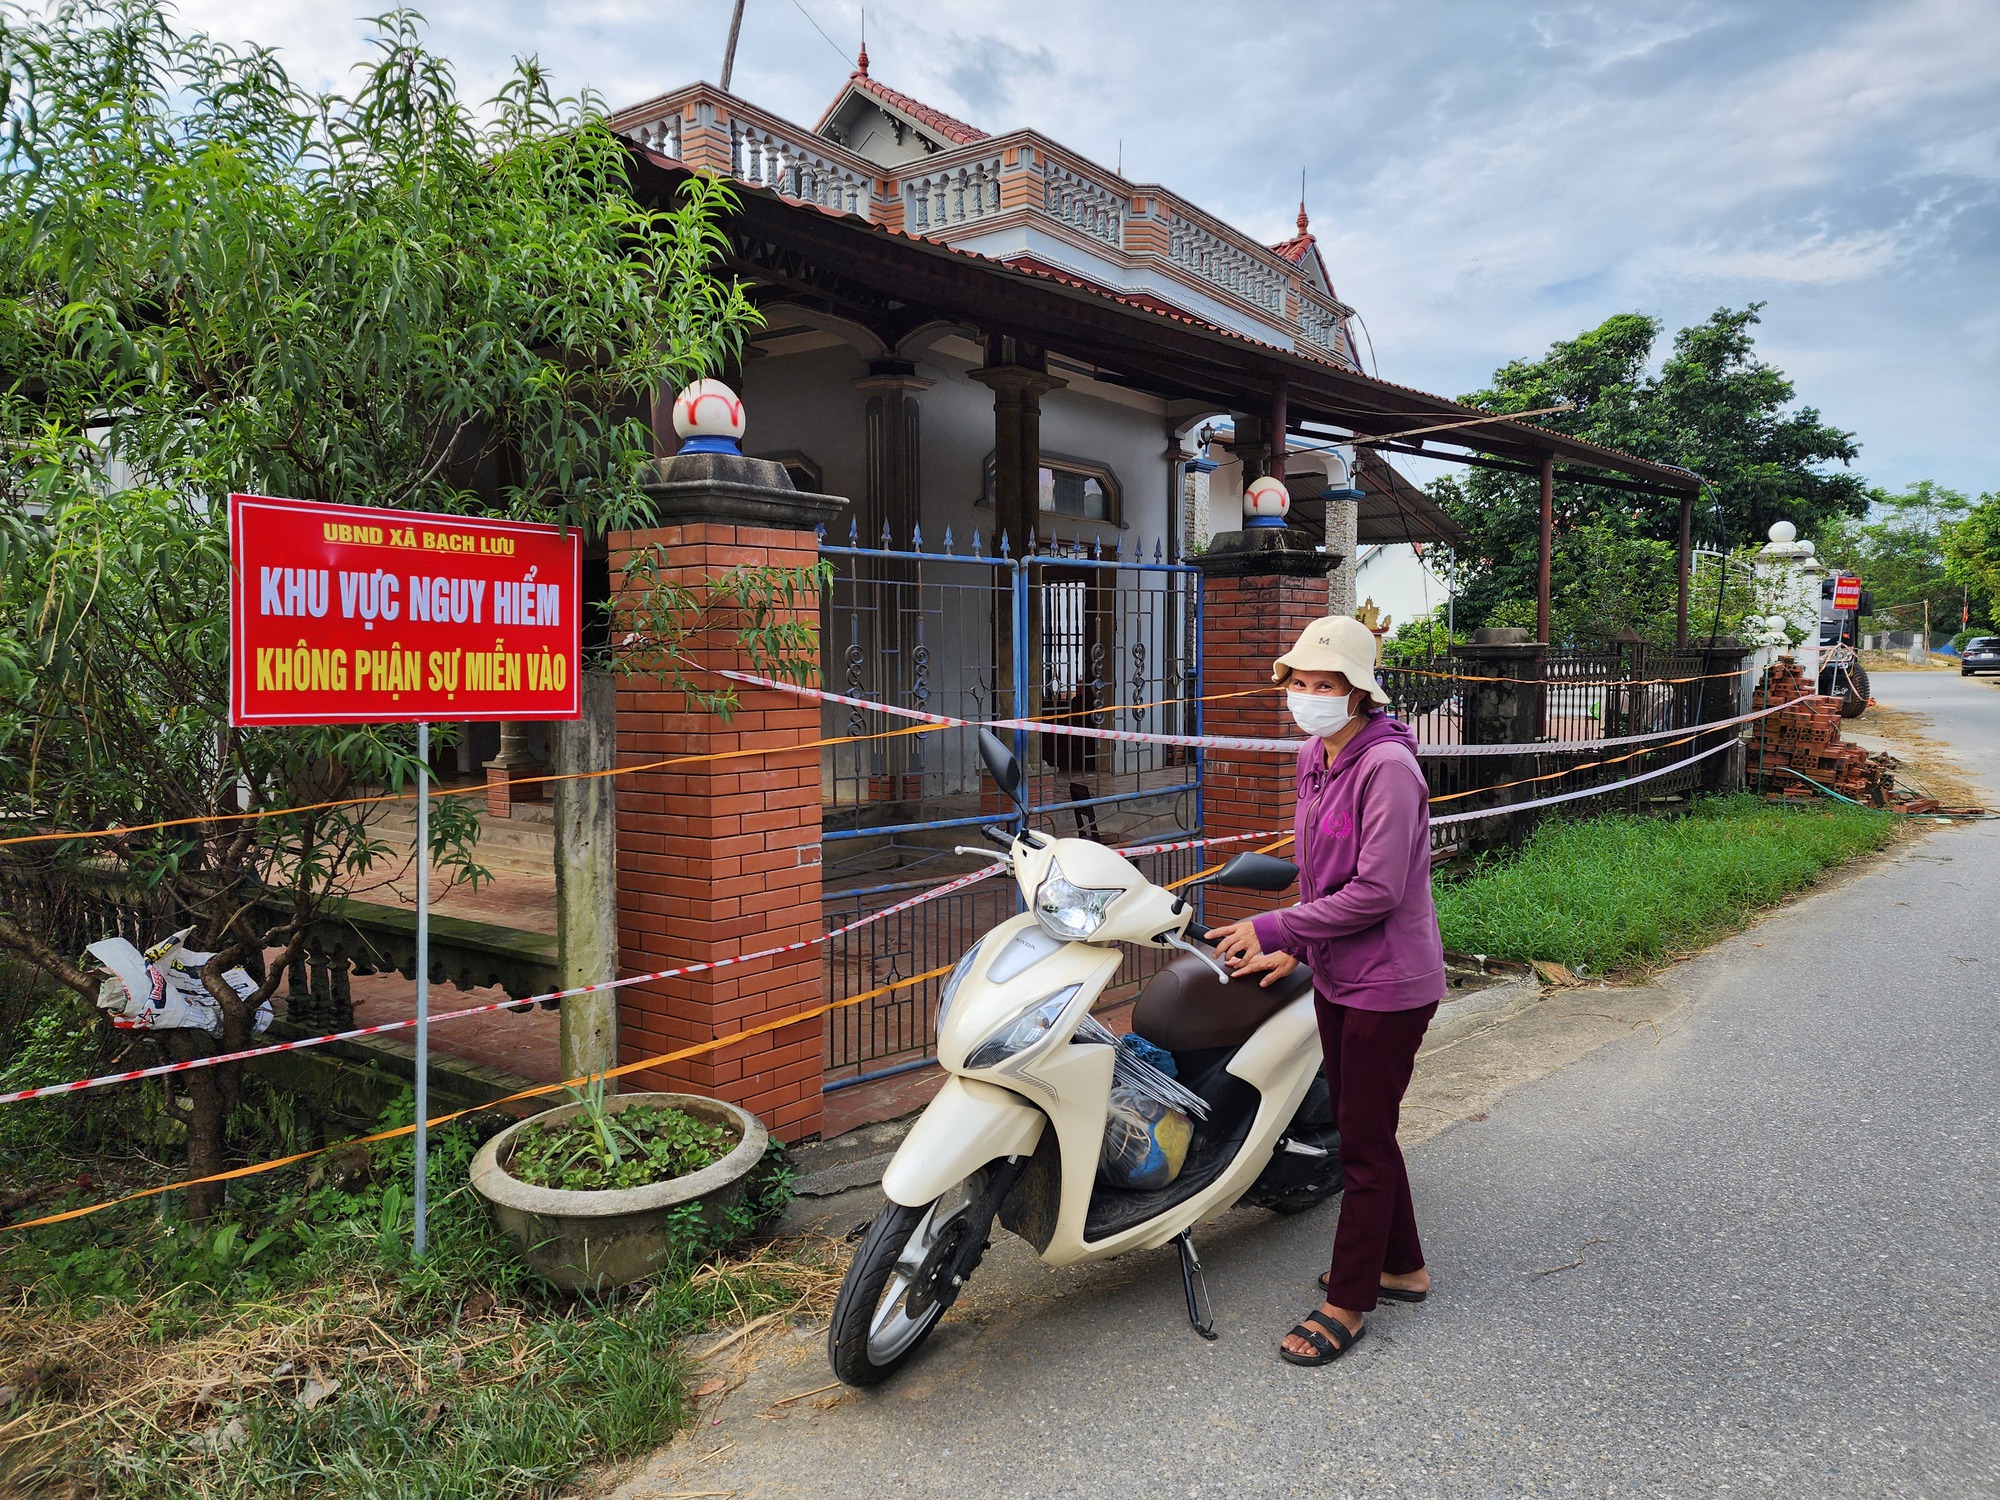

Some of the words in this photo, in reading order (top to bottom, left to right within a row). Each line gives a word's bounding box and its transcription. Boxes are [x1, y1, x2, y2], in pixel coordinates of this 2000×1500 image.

[323, 522, 383, 545] UBND
[389, 526, 418, 548] XÃ
[423, 531, 475, 554] BẠCH
[481, 536, 515, 555] LƯU
[260, 566, 329, 618] KHU
[339, 568, 400, 630] VỰC
[409, 575, 486, 624] NGUY
[494, 564, 560, 627] HIỂM
[1318, 637, 1330, 646] M
[256, 638, 347, 692] KHÔNG
[355, 641, 421, 700] PHẬN
[428, 647, 461, 700] SỰ
[465, 637, 521, 691] MIỄN
[527, 645, 567, 691] VÀO
